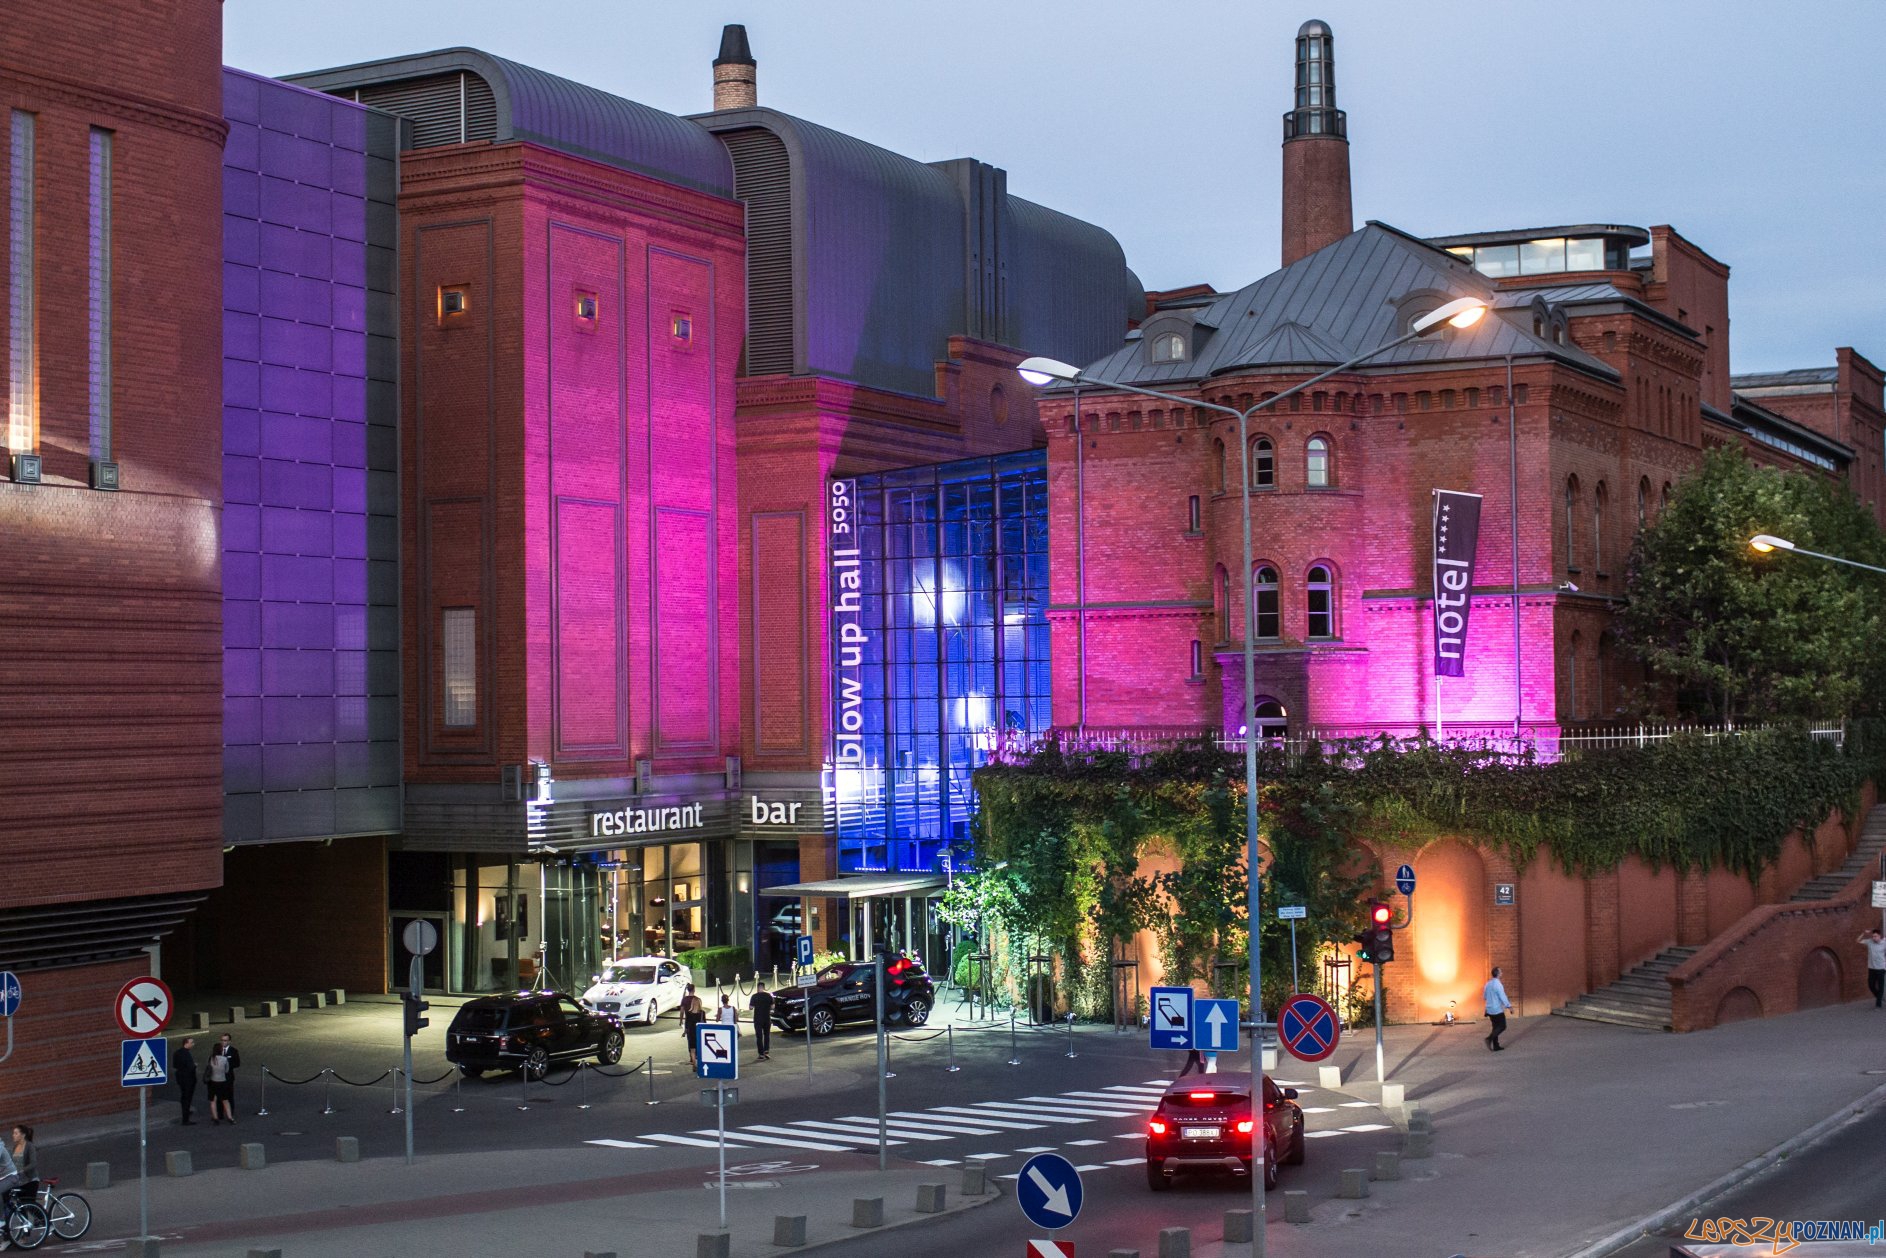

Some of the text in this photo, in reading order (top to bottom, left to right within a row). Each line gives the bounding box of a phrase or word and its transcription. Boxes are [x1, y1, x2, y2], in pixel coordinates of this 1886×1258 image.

[832, 481, 869, 765] blow up hall 5050
[593, 801, 704, 837] restaurant
[751, 795, 802, 825] bar
[1499, 886, 1510, 895] 42
[800, 939, 811, 963] P
